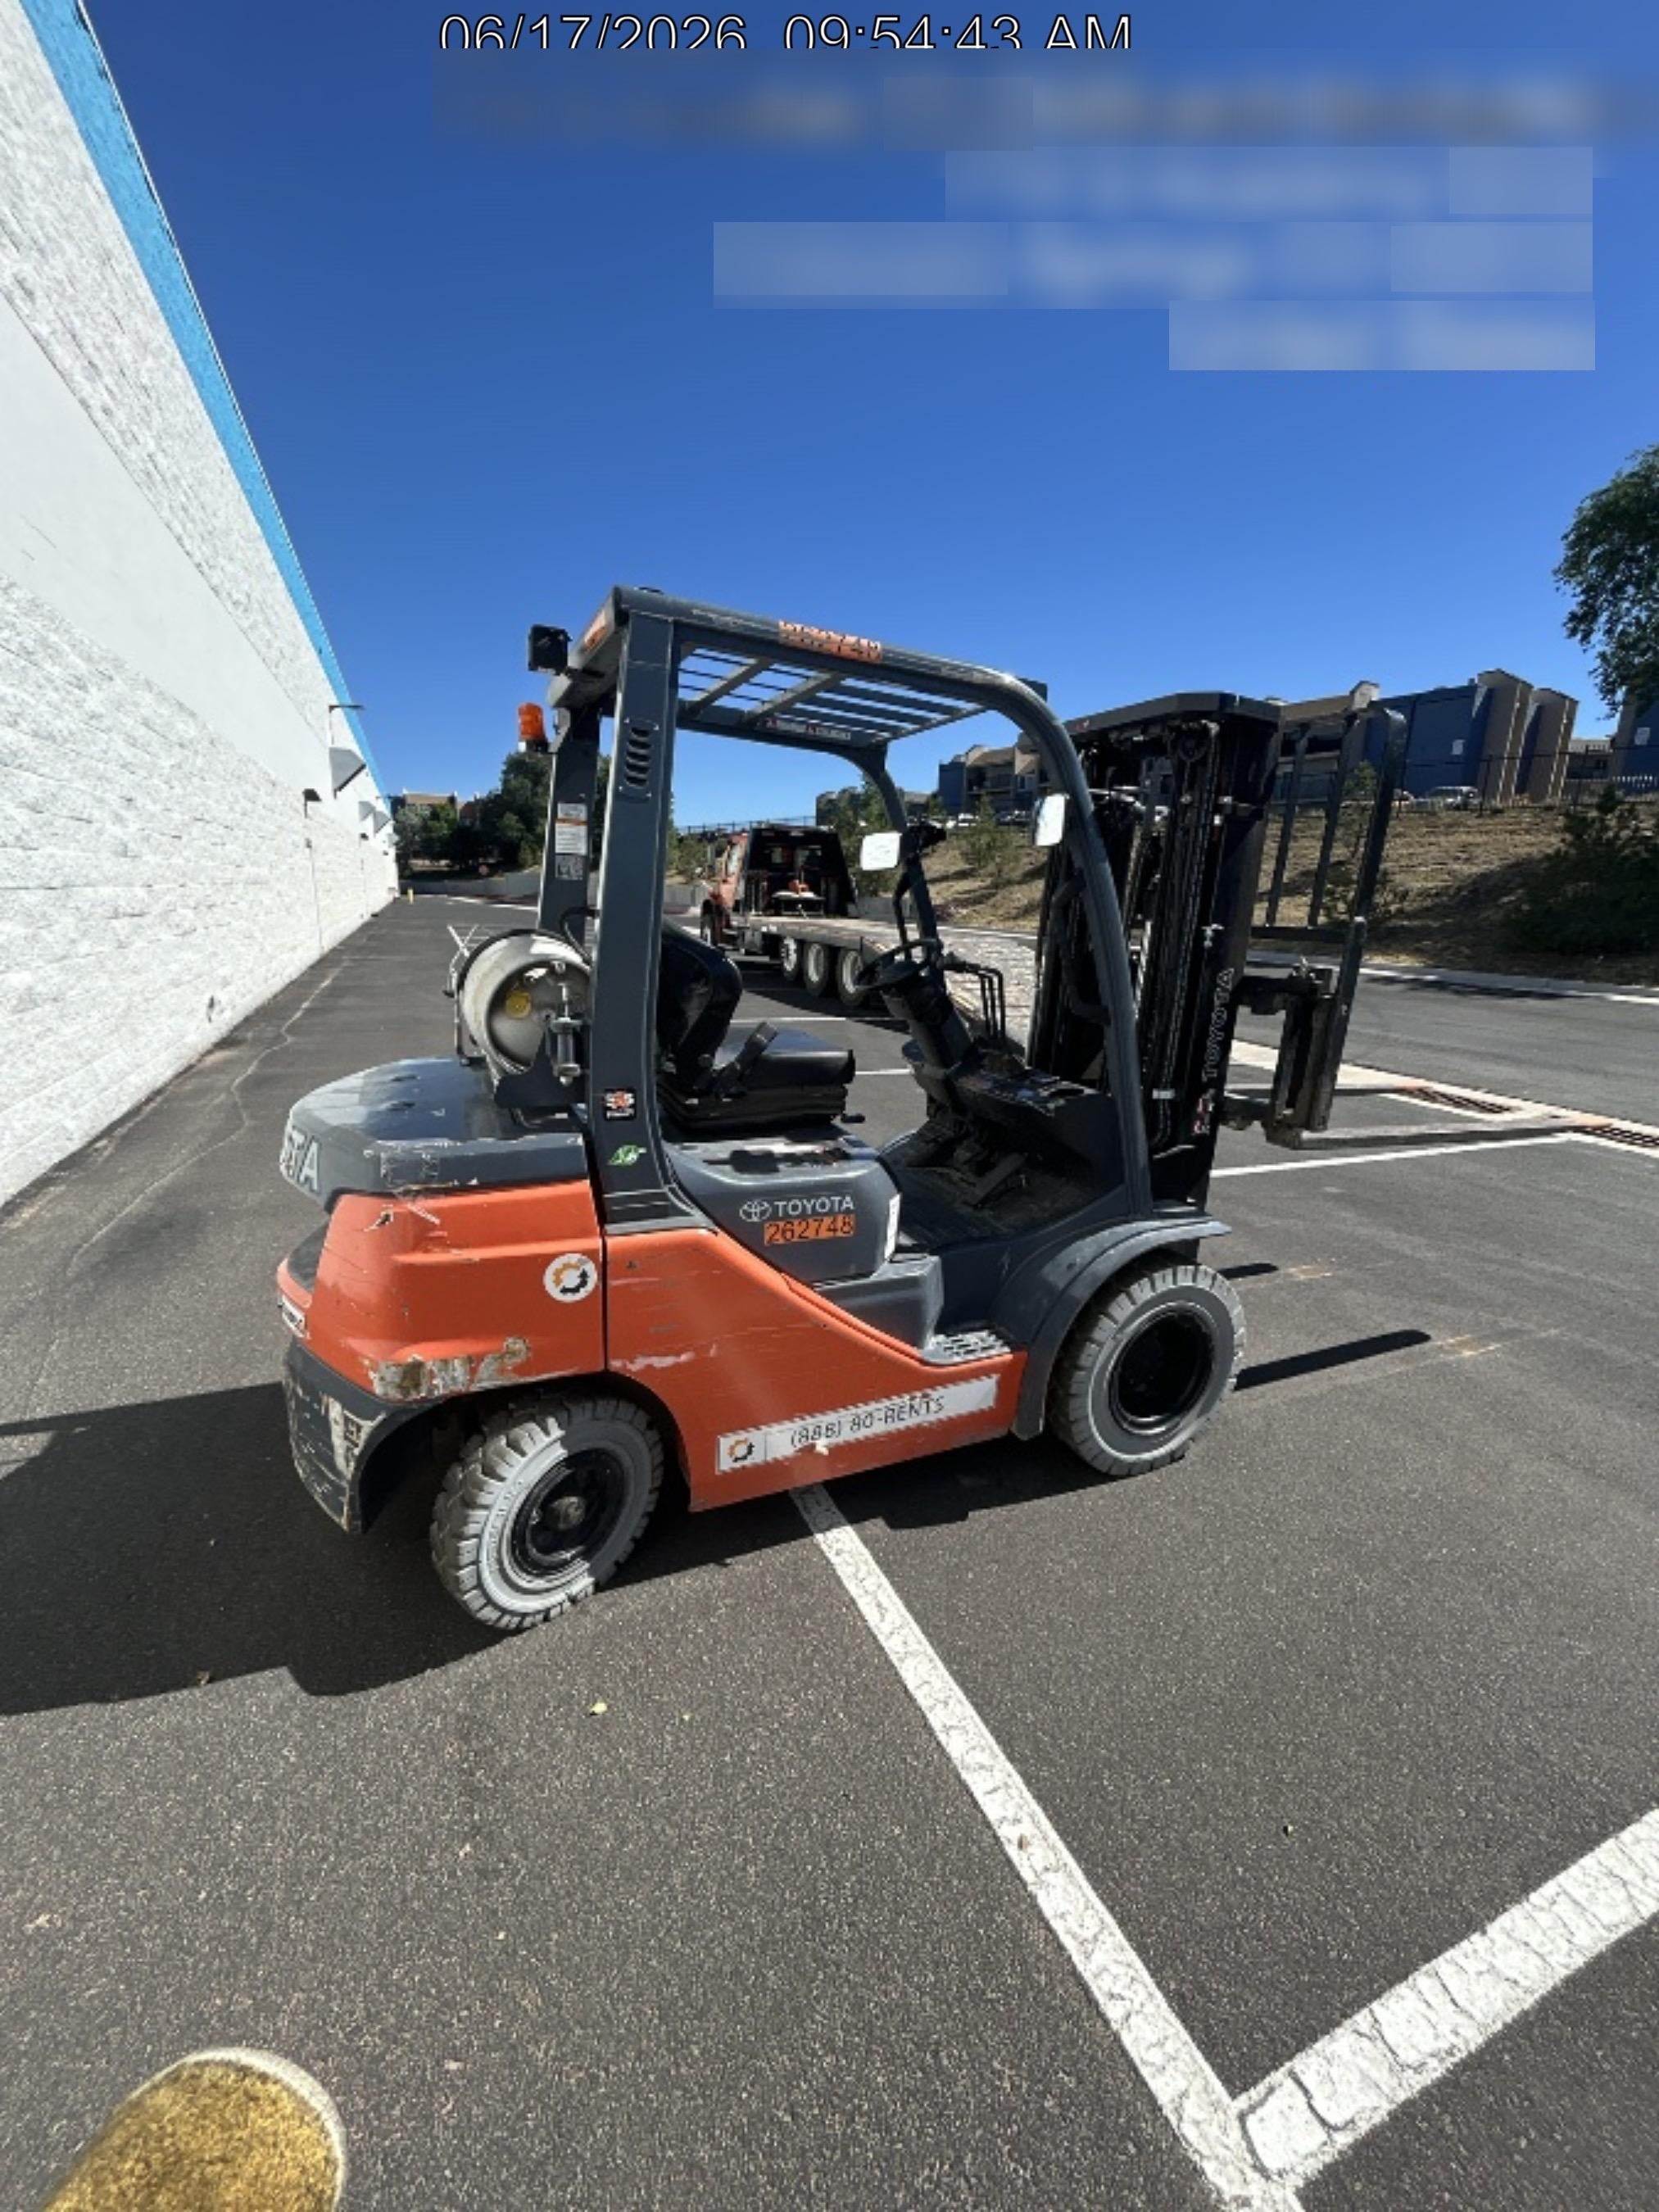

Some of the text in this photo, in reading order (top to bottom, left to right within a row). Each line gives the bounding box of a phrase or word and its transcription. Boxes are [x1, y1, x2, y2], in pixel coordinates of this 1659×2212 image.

[1202, 968, 1235, 1082] TOYOTA
[773, 1195, 854, 1217] TOYOTA
[765, 1216, 854, 1244] 262748
